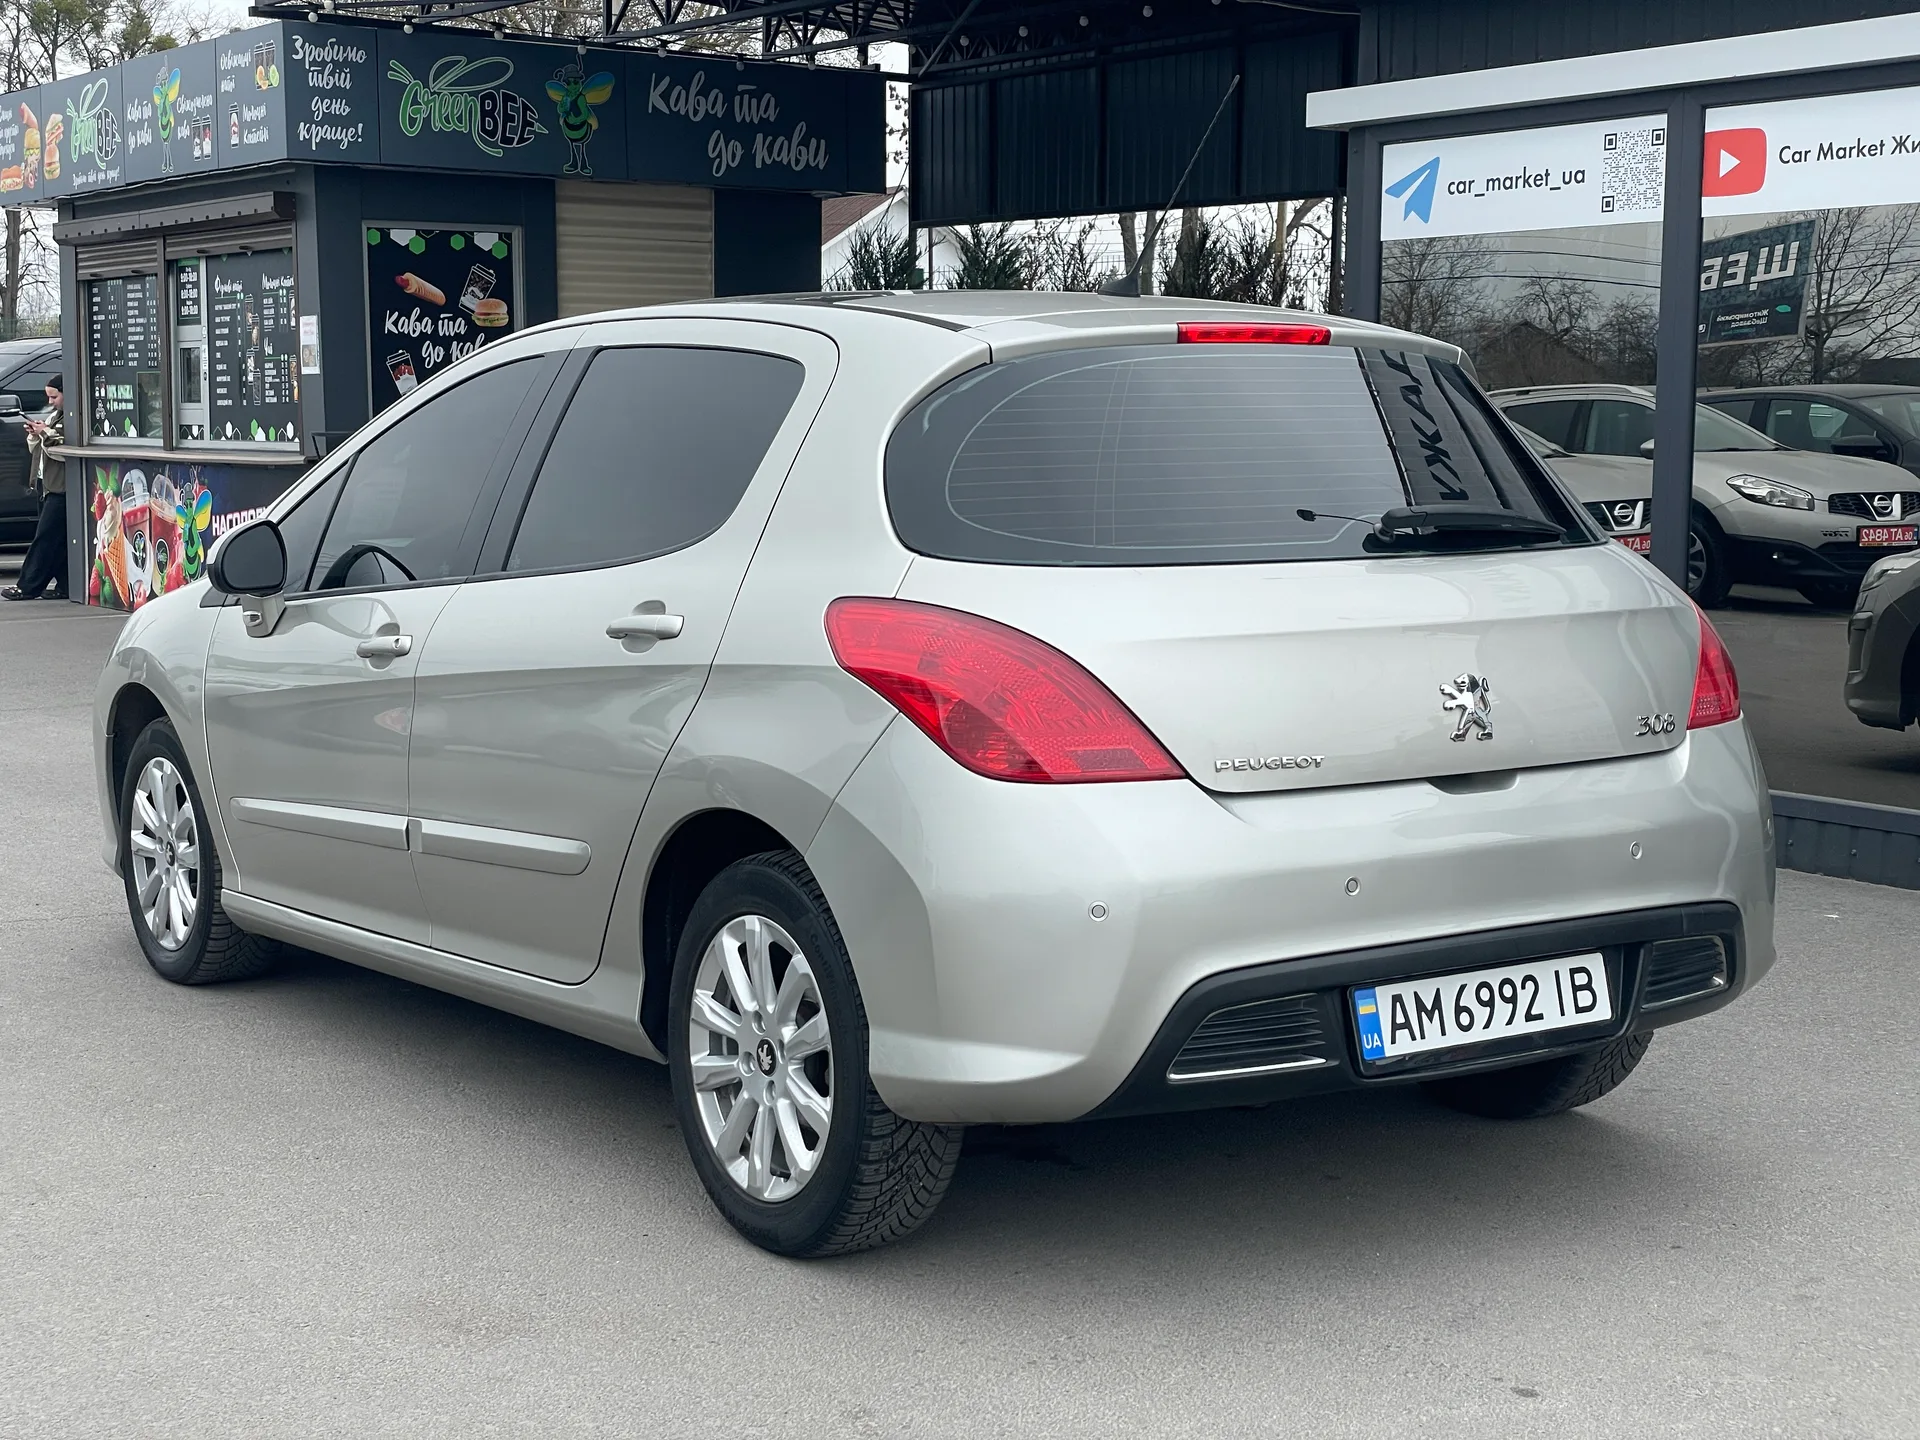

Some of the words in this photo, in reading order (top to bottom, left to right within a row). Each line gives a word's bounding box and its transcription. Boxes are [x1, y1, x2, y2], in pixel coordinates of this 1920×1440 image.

[292, 35, 367, 69] Зробимо
[308, 63, 352, 90] твій
[311, 95, 351, 122] день
[648, 70, 728, 122] Кава
[734, 84, 780, 124] та
[297, 123, 364, 150] краще!
[708, 129, 744, 177] до
[752, 121, 829, 171] кави
[1779, 146, 1811, 164] Car
[1817, 138, 1885, 162] Market
[1447, 166, 1586, 197] car_market_ua
[385, 307, 434, 338] Кава
[438, 313, 468, 337] та
[422, 340, 445, 369] до
[1634, 713, 1676, 737] 308
[1215, 755, 1325, 773] PEUGEOT
[1390, 987, 1447, 1045] AM
[1454, 974, 1545, 1033] 6992
[1554, 966, 1598, 1018] IB
[1363, 1033, 1382, 1049] UA
